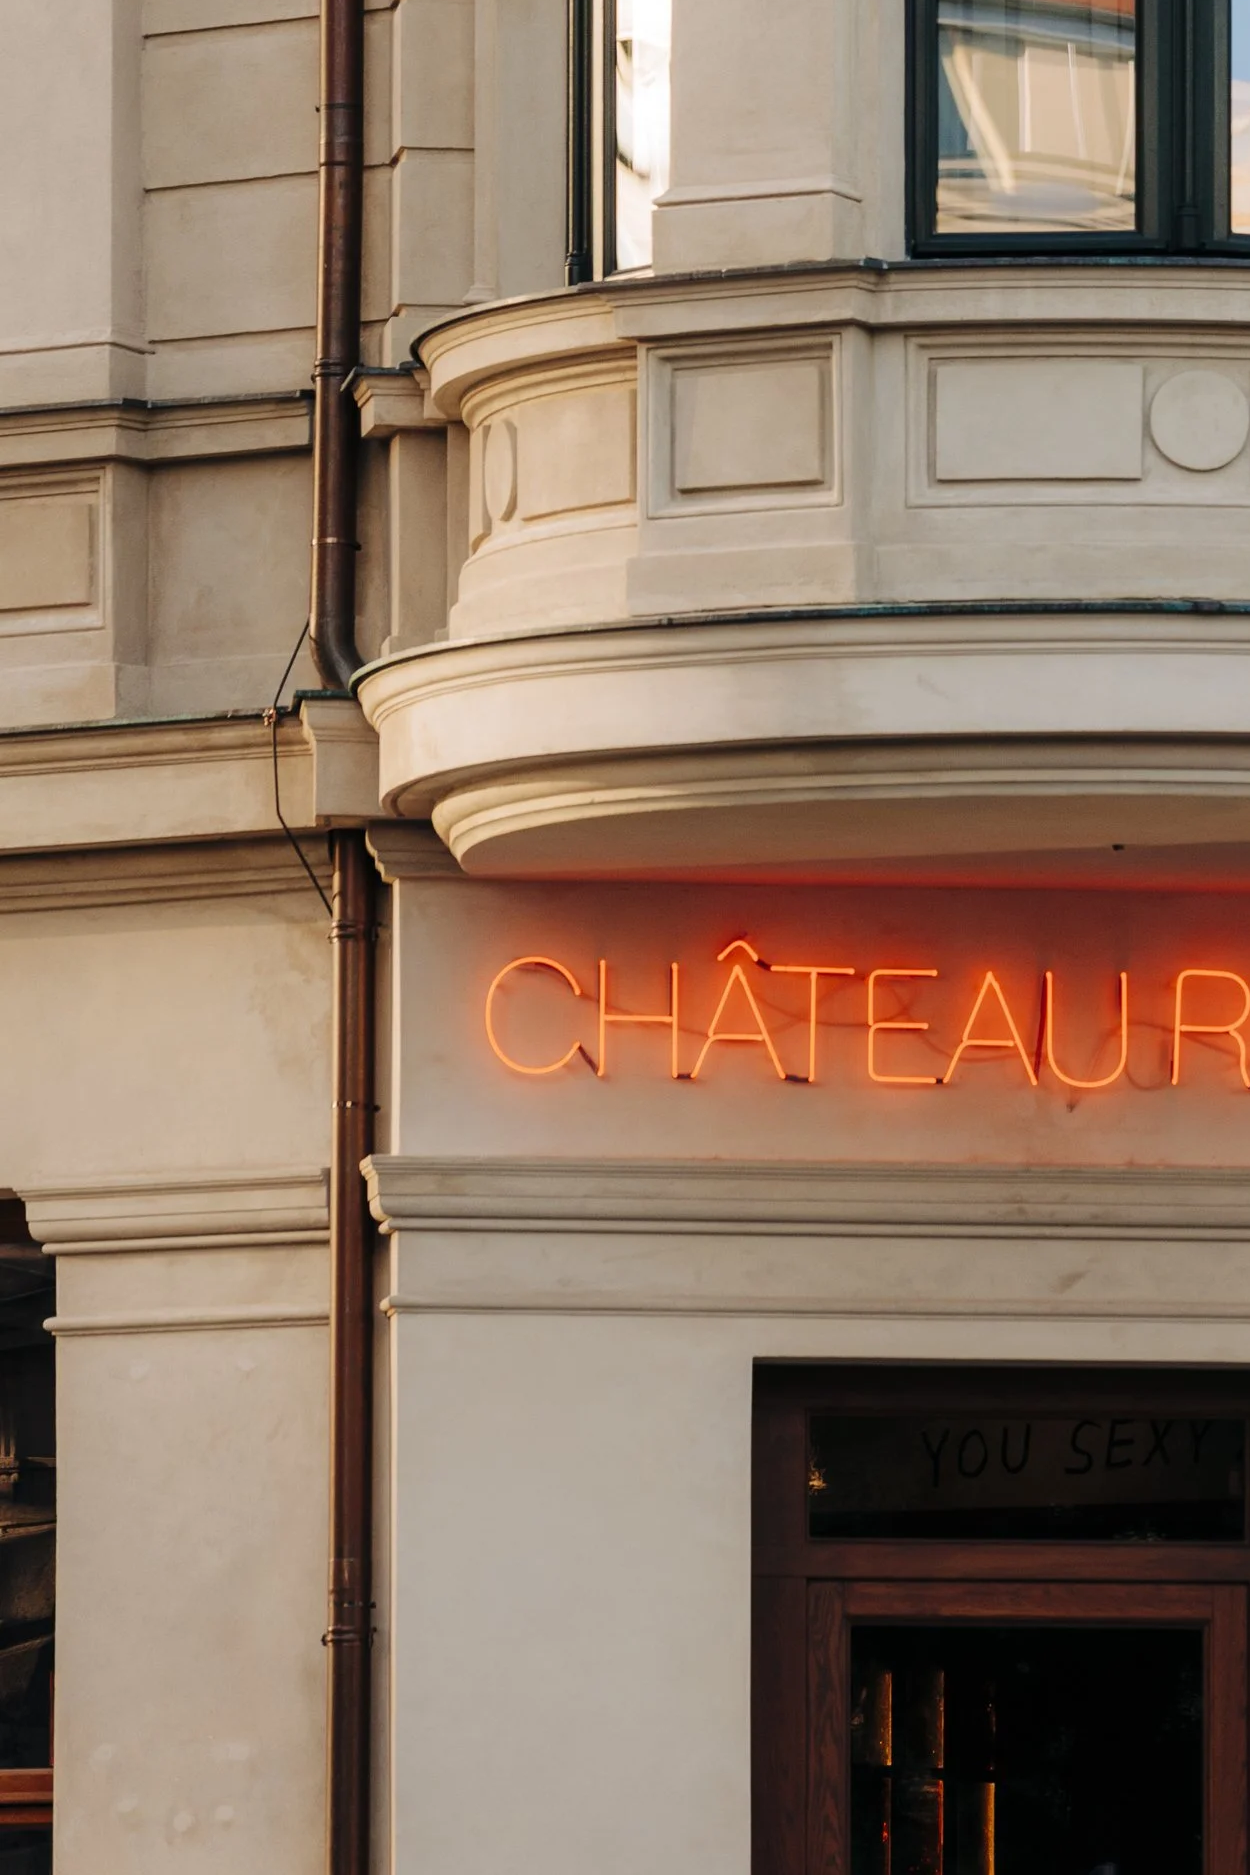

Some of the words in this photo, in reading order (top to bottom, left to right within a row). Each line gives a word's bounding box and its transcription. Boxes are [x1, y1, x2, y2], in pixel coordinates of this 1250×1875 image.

[484, 939, 1128, 1088] CHÂTEAU
[921, 1424, 1030, 1488] YOU
[1064, 1419, 1213, 1475] SEXY
